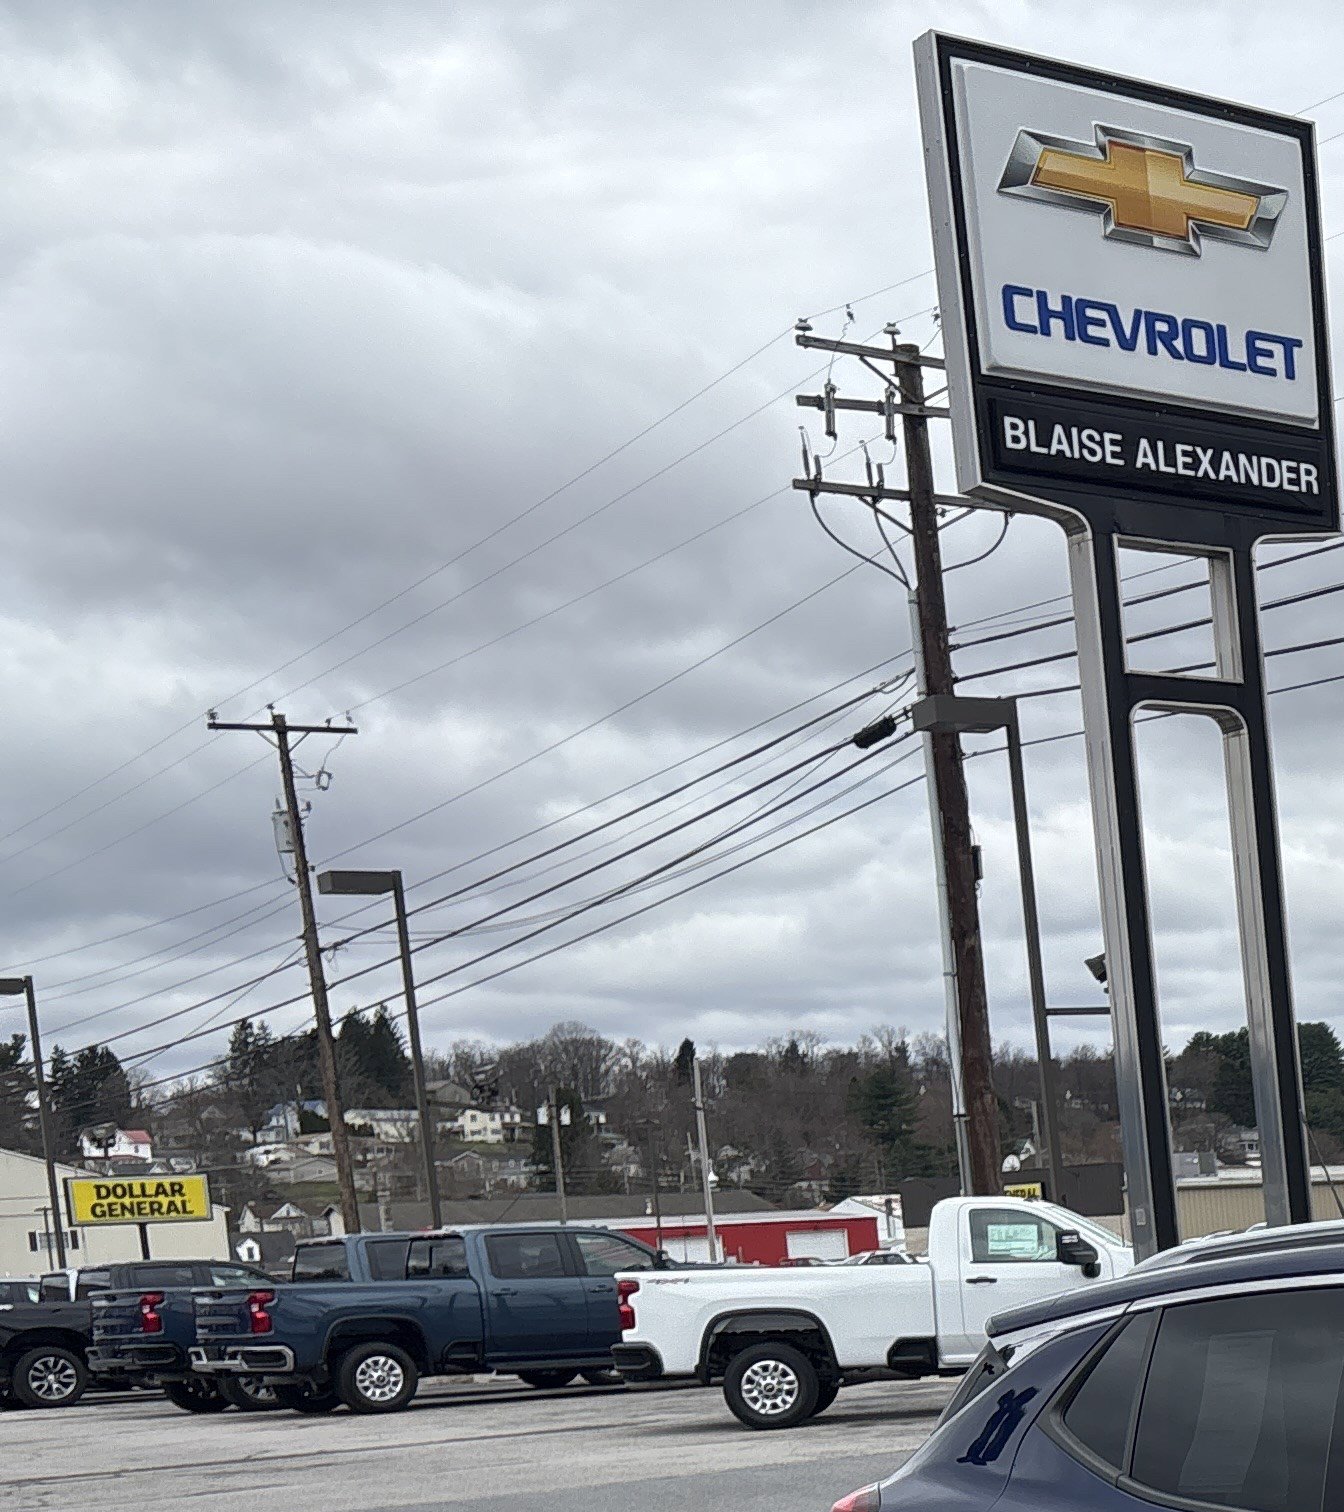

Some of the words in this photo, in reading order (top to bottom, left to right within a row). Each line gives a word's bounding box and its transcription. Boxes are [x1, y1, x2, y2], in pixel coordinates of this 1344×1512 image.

[1002, 284, 1303, 381] CHEVROLET
[1003, 415, 1125, 466] BLAISE
[1135, 437, 1320, 496] ALEXANDER
[90, 1200, 195, 1219] GENERAL
[93, 1182, 185, 1200] DOLLAR
